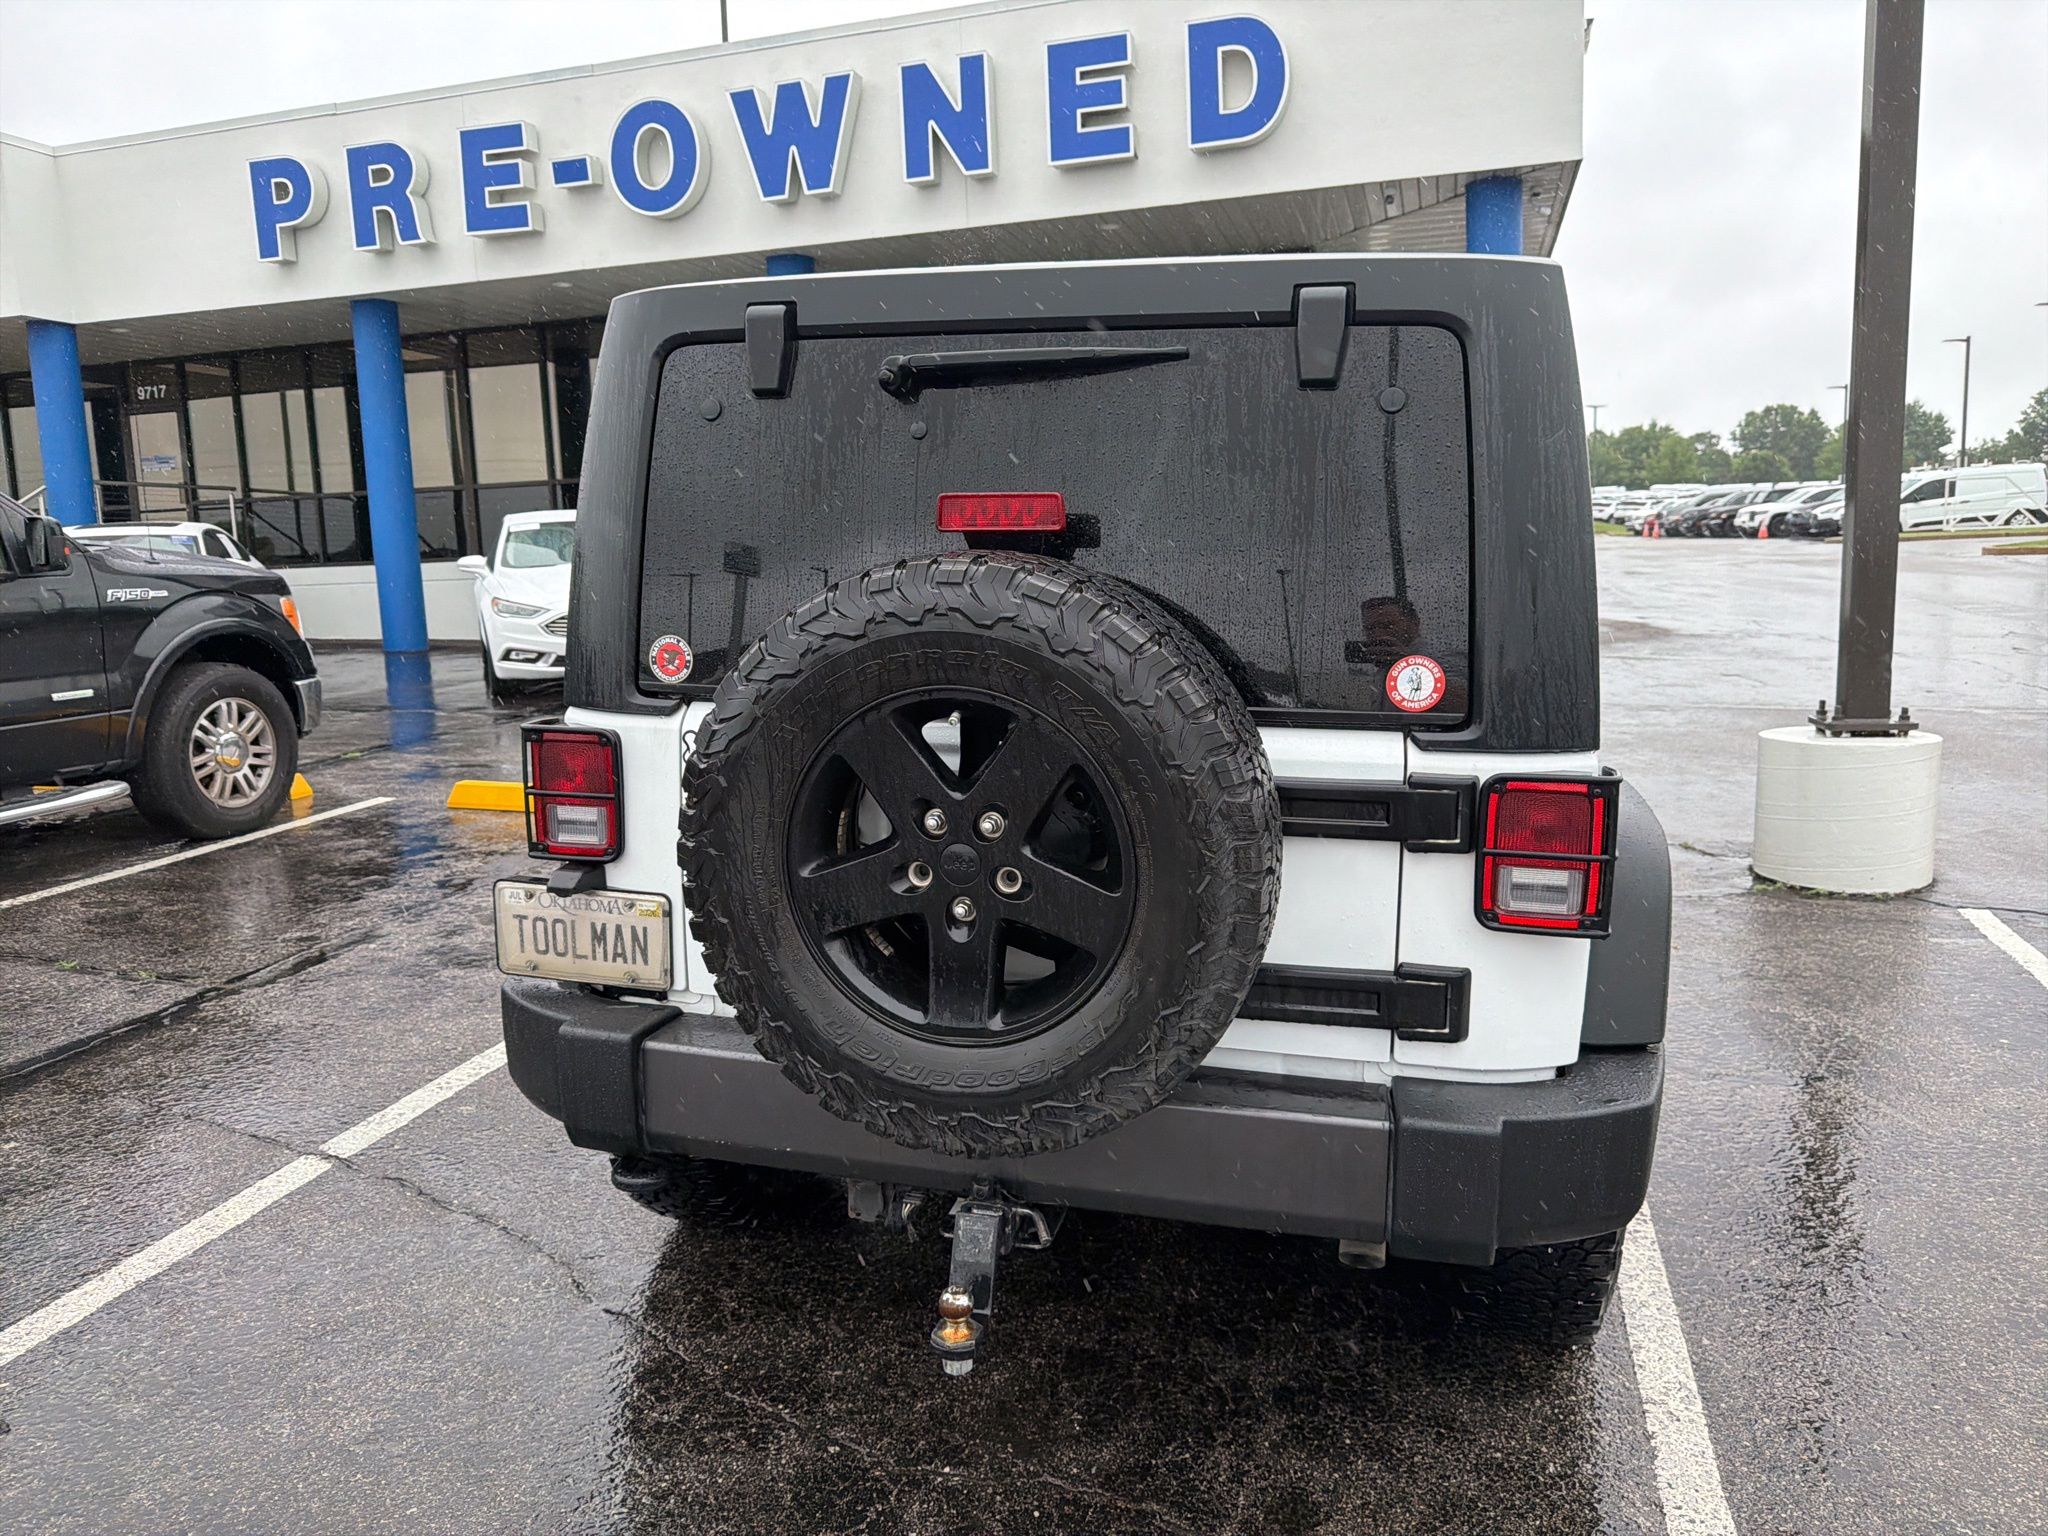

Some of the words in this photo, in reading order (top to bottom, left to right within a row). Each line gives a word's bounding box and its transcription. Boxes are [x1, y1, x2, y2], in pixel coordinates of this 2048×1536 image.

[247, 14, 1291, 264] PRE-OWNED
[137, 385, 167, 400] 9717
[651, 637, 678, 657] NATIONAL
[678, 641, 691, 661] RIFLE
[652, 664, 689, 682] ASSOCIATION
[1391, 661, 1408, 677] GUN
[1408, 657, 1442, 679] OWNERS
[1391, 691, 1402, 703] OF
[1401, 692, 1440, 709] AMERICA
[943, 860, 977, 872] Jeep
[508, 891, 522, 900] JUL
[512, 914, 650, 966] TOOLMAN
